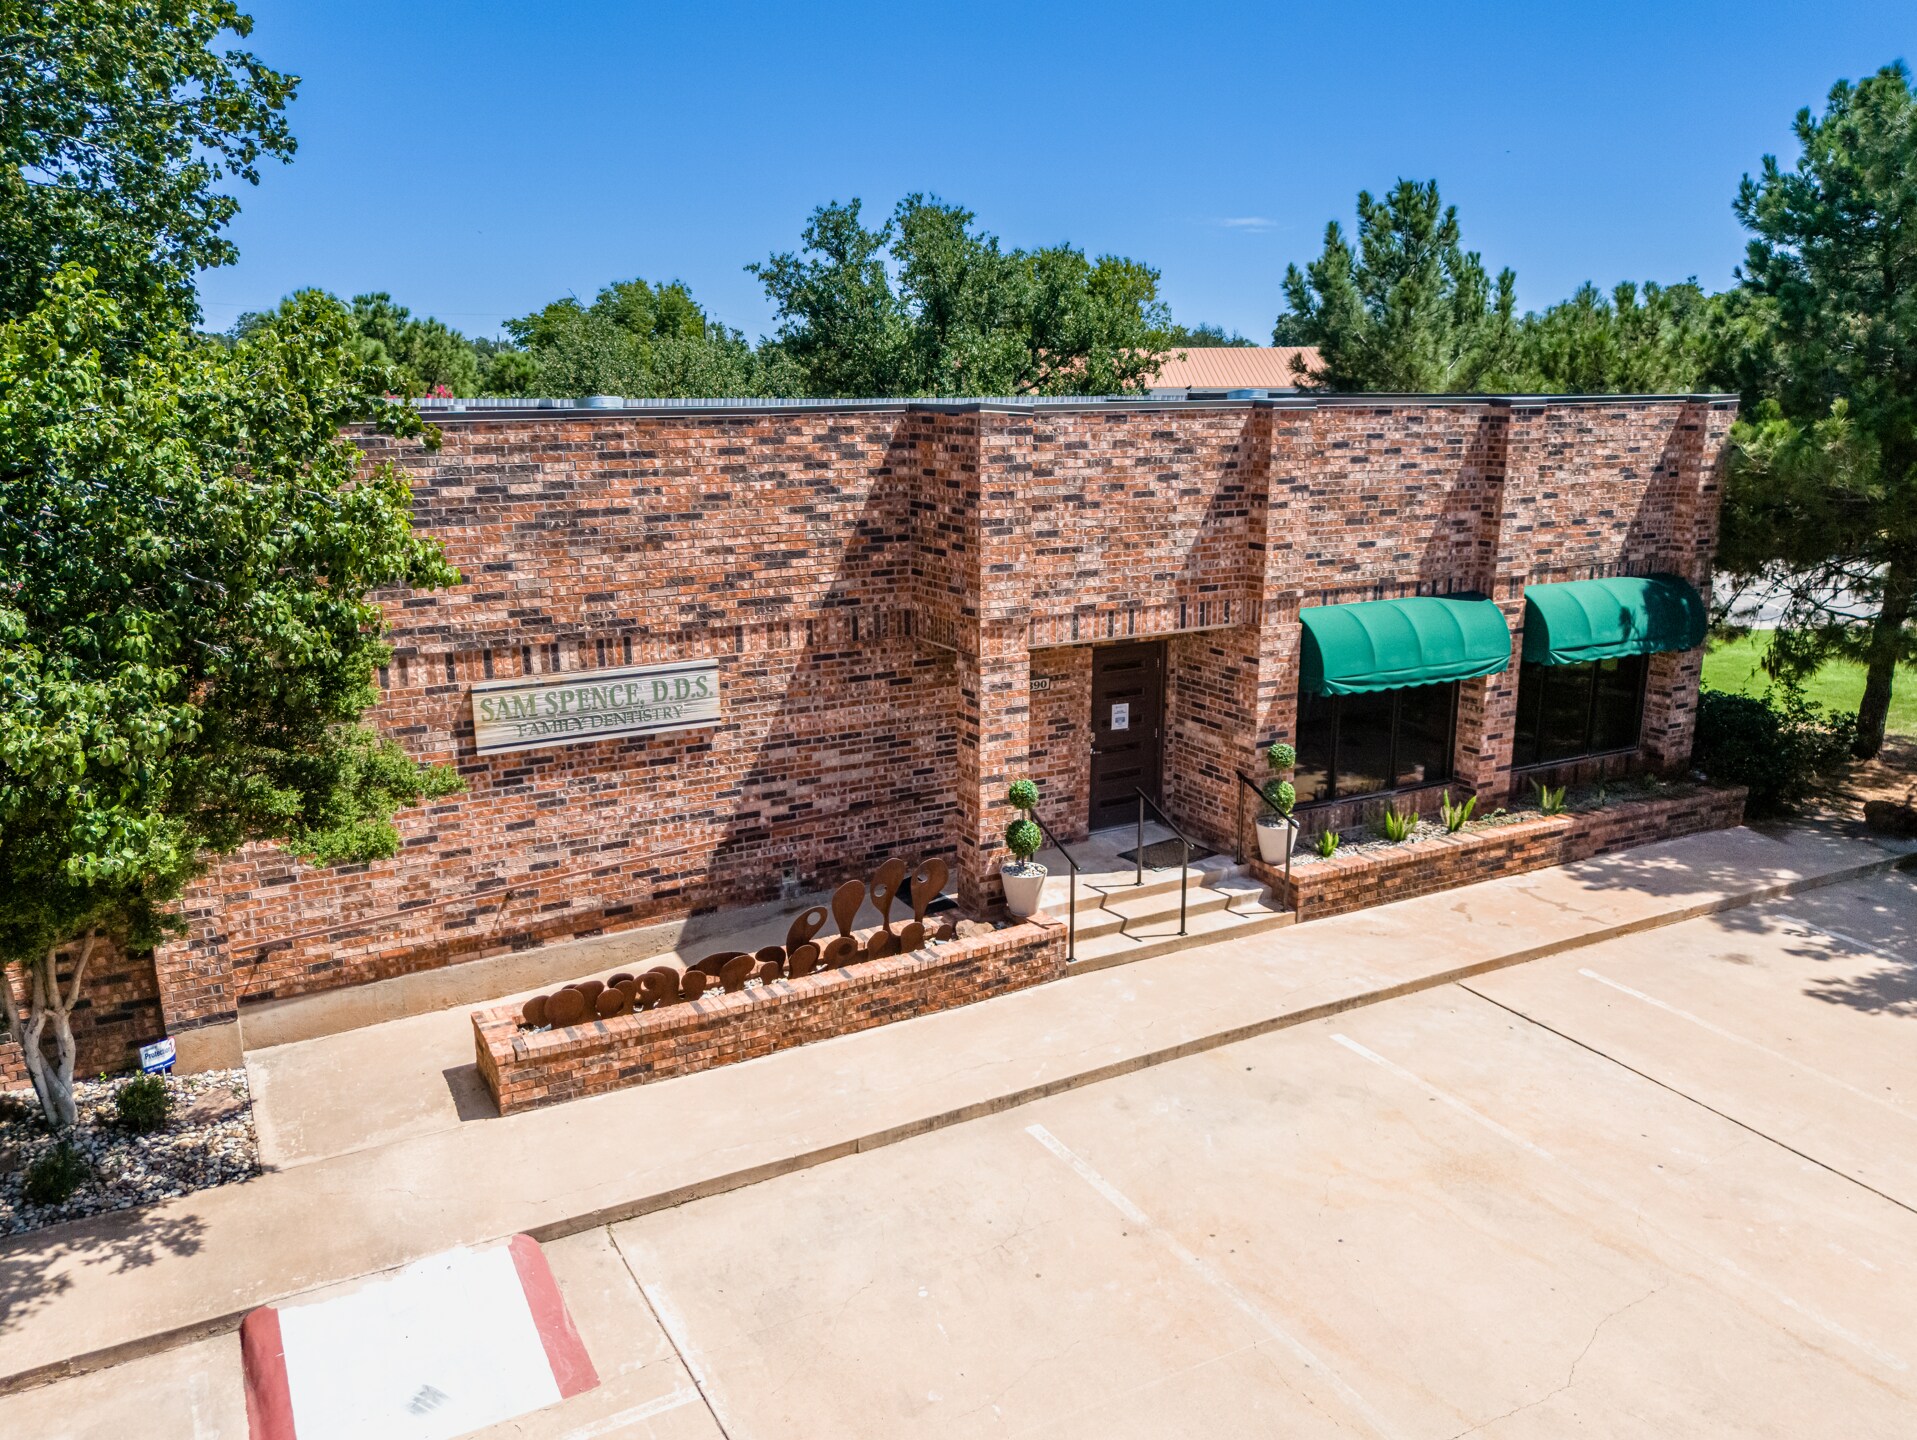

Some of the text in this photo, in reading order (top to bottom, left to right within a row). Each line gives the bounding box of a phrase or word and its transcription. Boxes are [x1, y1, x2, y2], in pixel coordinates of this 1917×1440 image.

[480, 676, 714, 722] SAM SPENCE, D.D.S.
[516, 705, 684, 737] FAMILY DENTISTRY
